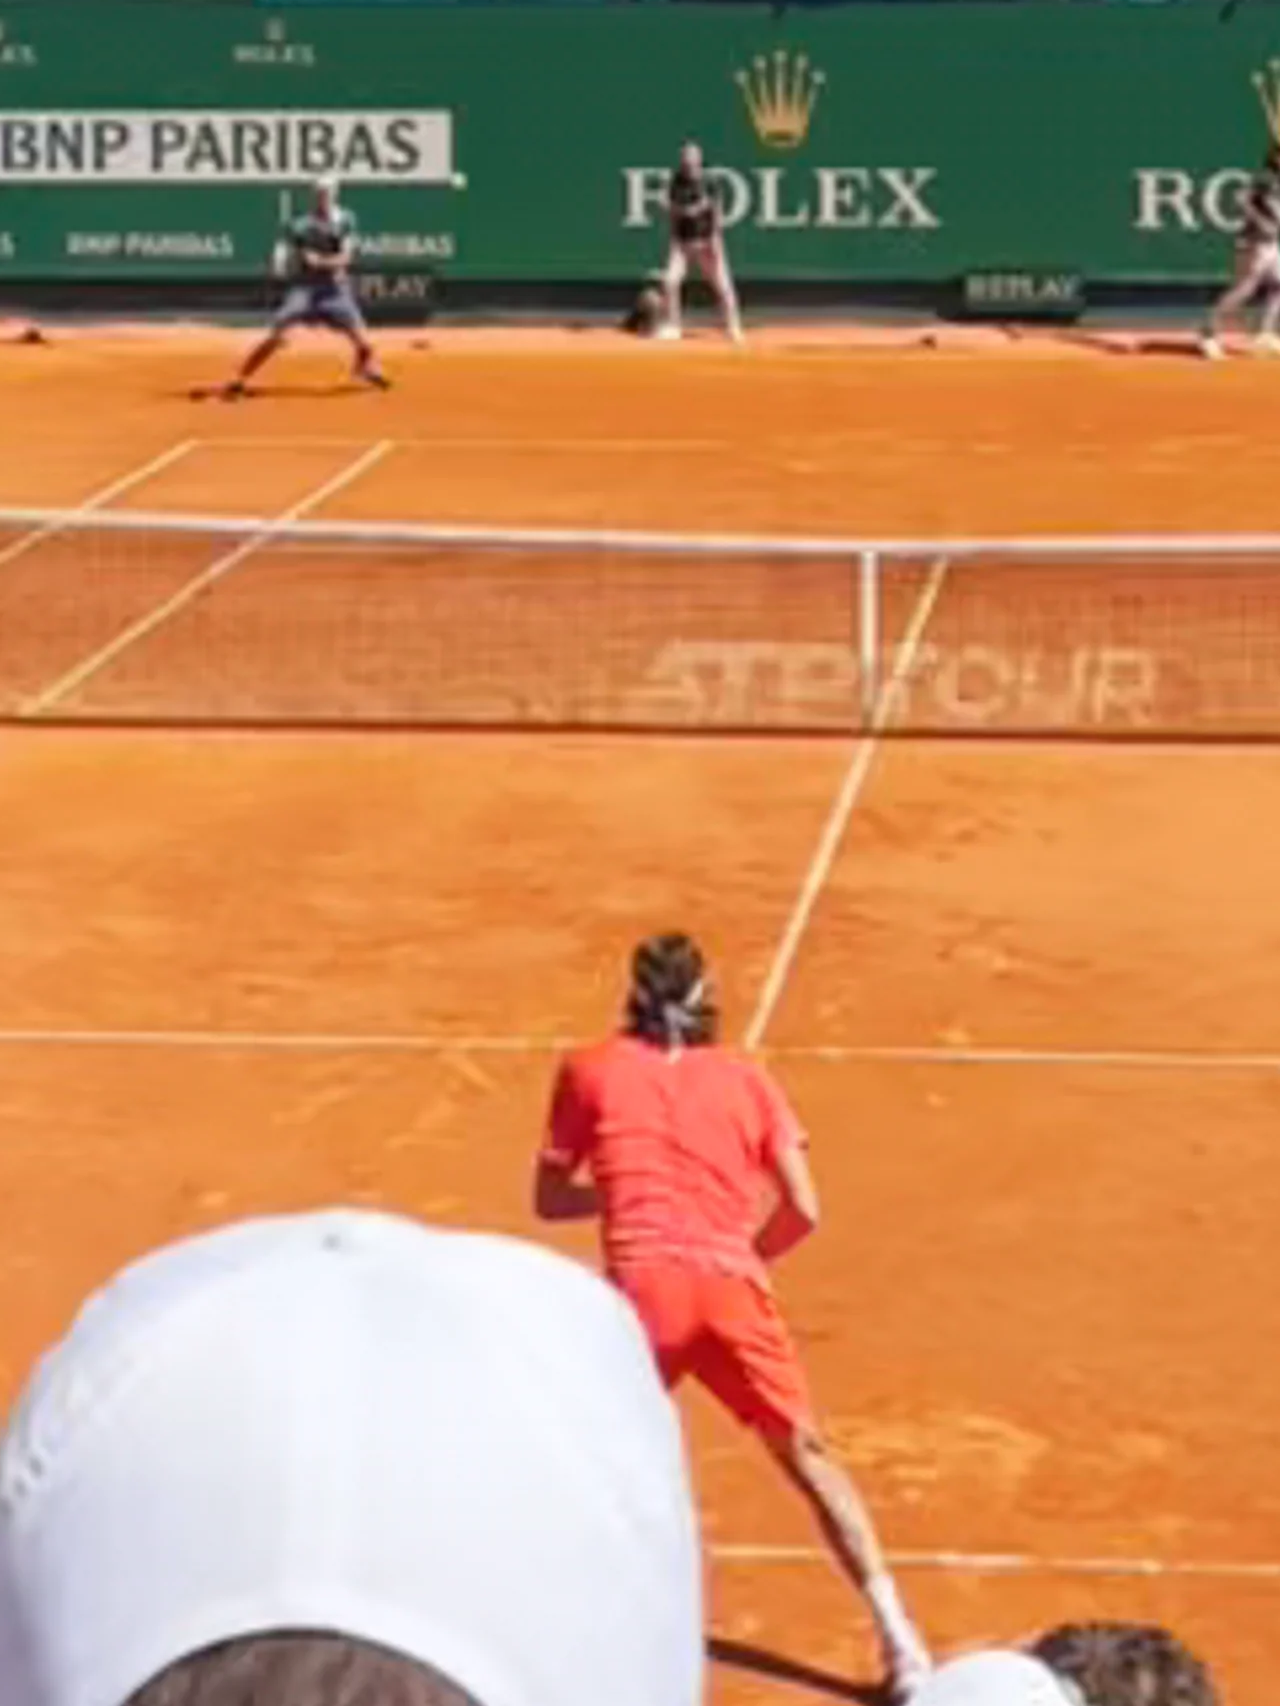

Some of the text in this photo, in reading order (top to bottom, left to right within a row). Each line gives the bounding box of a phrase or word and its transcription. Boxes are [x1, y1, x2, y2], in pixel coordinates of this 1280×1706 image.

[0, 119, 420, 173] BNP PARIBAS
[622, 164, 941, 228] ROLEX
[124, 233, 233, 257] PARIBAS
[964, 276, 1080, 302] REPLAY
